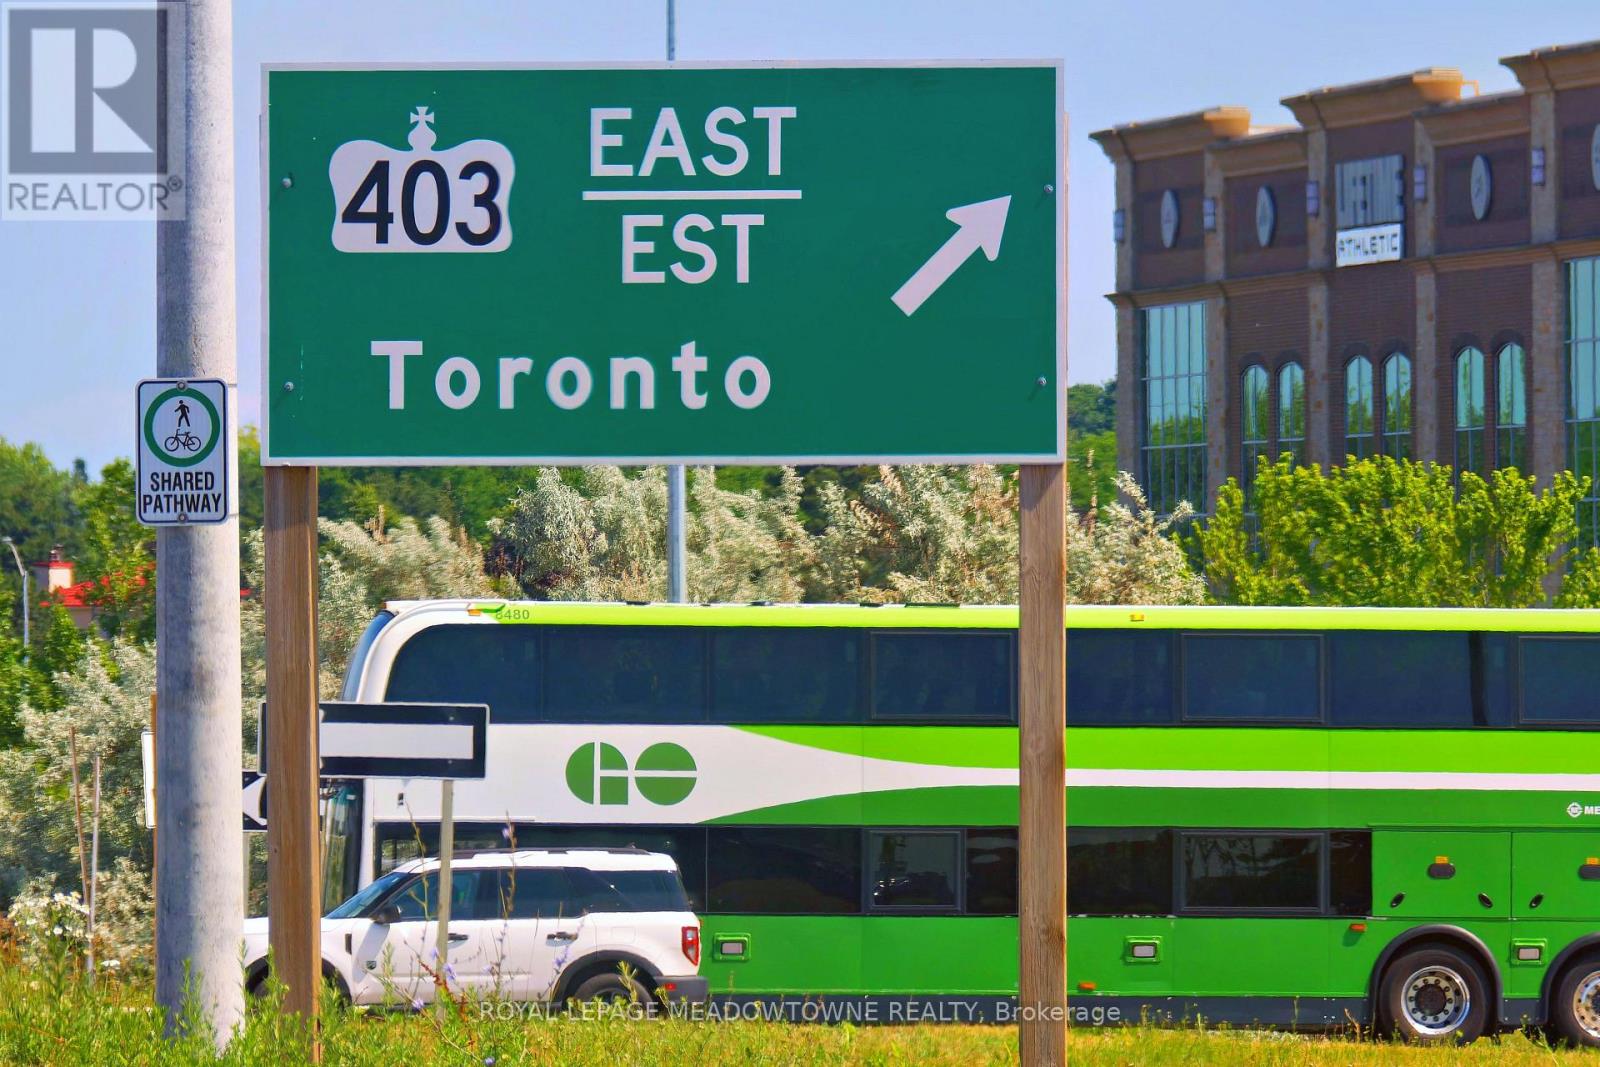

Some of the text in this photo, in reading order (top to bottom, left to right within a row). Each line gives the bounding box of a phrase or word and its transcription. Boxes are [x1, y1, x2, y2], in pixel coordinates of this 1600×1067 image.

[590, 106, 797, 177] EAST
[341, 160, 502, 246] 403
[621, 214, 765, 284] EST
[1338, 232, 1399, 258] ATHLETIC
[370, 340, 771, 410] Toronto
[142, 493, 221, 513] PATHWAY
[150, 471, 215, 492] SHARED
[565, 741, 697, 806] GO
